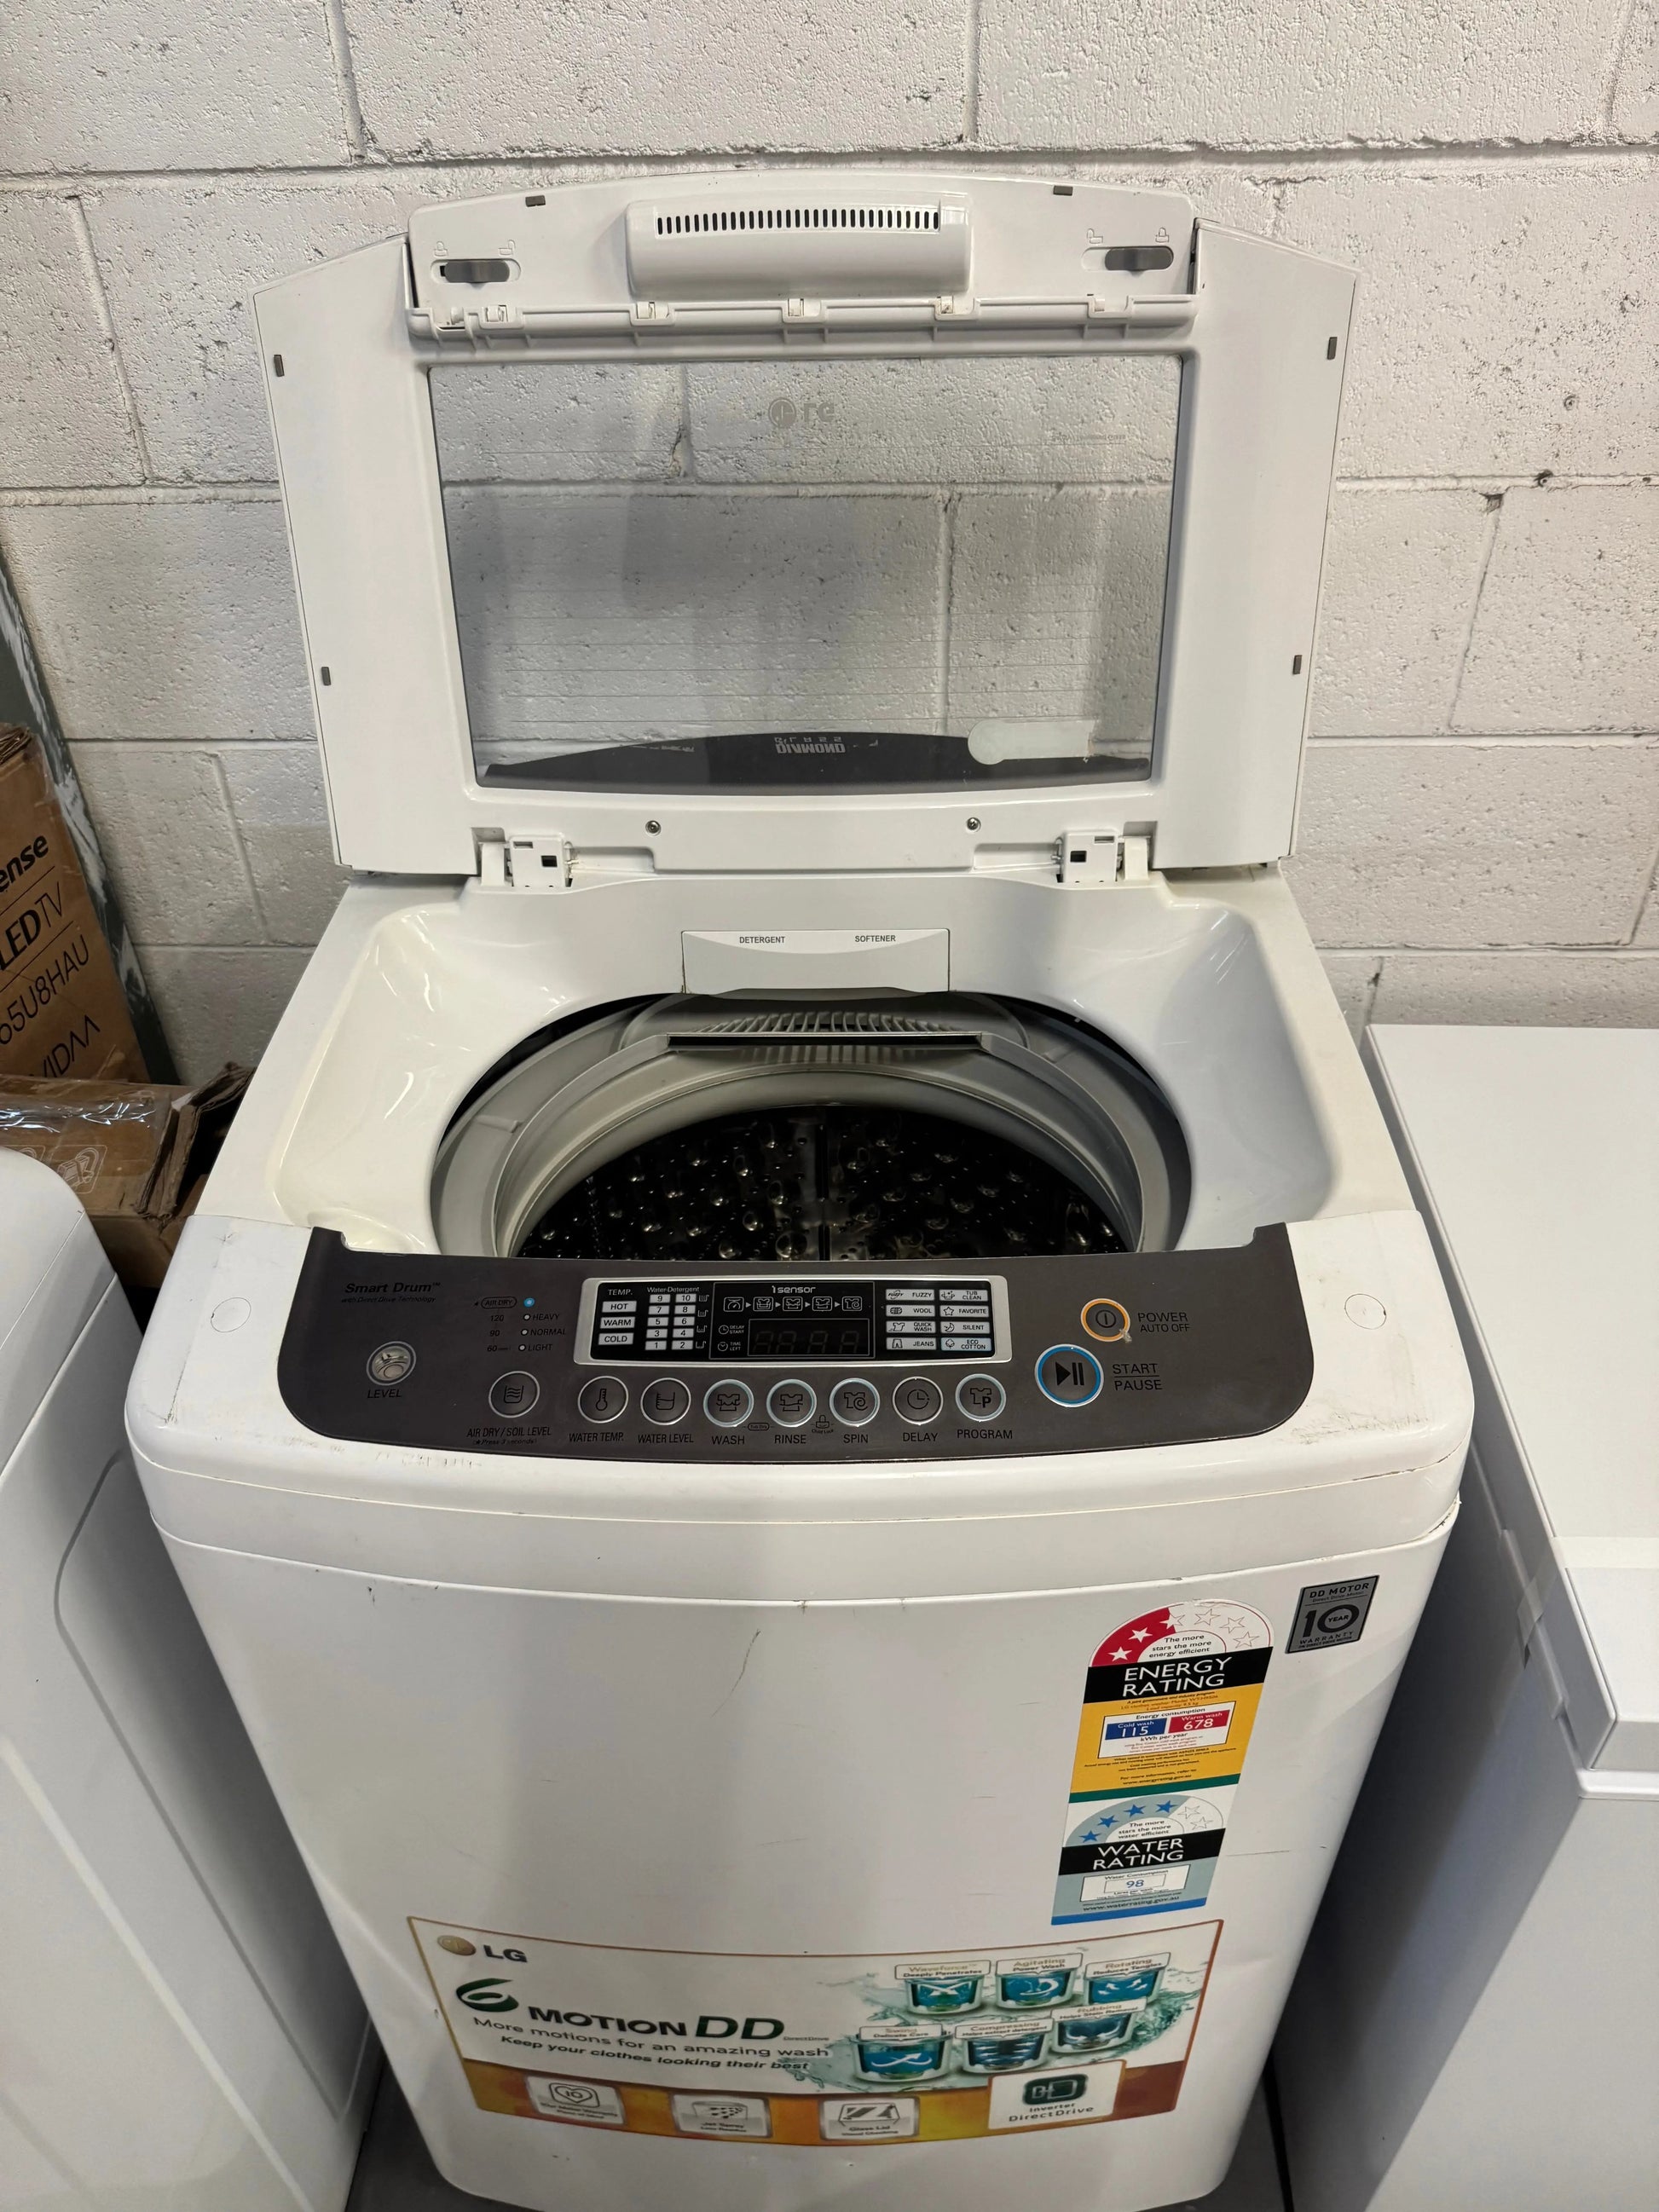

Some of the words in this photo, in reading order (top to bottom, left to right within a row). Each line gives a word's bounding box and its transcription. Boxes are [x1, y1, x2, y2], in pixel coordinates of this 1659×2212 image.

[344, 1283, 388, 1293] Smart
[610, 1302, 628, 1311] HOT
[1137, 1312, 1188, 1323] POWER
[1140, 1324, 1169, 1332] AUTO
[1171, 1323, 1190, 1332] OFF
[1112, 1363, 1158, 1375] START
[1114, 1379, 1163, 1391] PAUSE
[367, 1388, 402, 1399] LEVEL
[467, 1428, 481, 1438] AIR
[483, 1428, 500, 1438] DRY
[506, 1427, 525, 1437] SOIL
[527, 1426, 552, 1436] LEVEL
[569, 1432, 598, 1442] WATER
[600, 1432, 624, 1442] TEMP.
[903, 1432, 938, 1441] DELAY
[957, 1429, 1013, 1440] PROGRAM
[639, 1434, 667, 1444] WATER
[669, 1434, 694, 1443] LEVEL
[711, 1435, 745, 1445] WASH
[774, 1434, 806, 1444] RINSE
[843, 1434, 869, 1443] SPIN
[1309, 1590, 1325, 1598] DD
[1328, 1582, 1370, 1596] MOTOR
[1302, 1603, 1360, 1637] 10
[1327, 1614, 1350, 1623] YEAR
[1299, 1631, 1354, 1644] WARRANTY
[1124, 1656, 1233, 1682] ENERGY
[1122, 1673, 1226, 1697] RATING
[1161, 1707, 1205, 1717] consumption
[1183, 1718, 1214, 1730] 678
[1122, 1725, 1148, 1737] 115
[1097, 1838, 1183, 1857] WATER
[1092, 1851, 1184, 1871] RATING
[1126, 1880, 1144, 1888] 98
[483, 1944, 528, 1963] LG
[1014, 1958, 1066, 1967] Agitating
[1105, 1959, 1153, 1969] Rotating
[456, 1978, 519, 2012] 6
[528, 2006, 688, 2036] MOTION
[695, 2015, 785, 2041] DD
[1077, 2004, 1122, 2013] Rubbing
[970, 2021, 1040, 2032] Compressing
[473, 2017, 523, 2033] More
[530, 2028, 611, 2045] motions
[617, 2038, 645, 2048] for
[652, 2043, 676, 2052] an
[684, 2045, 771, 2058] amazing
[777, 2047, 830, 2057] wash
[501, 2036, 543, 2049] Keep
[547, 2043, 587, 2055] your
[590, 2048, 652, 2062] clothes
[657, 2053, 722, 2068] looking
[726, 2060, 766, 2069] their
[771, 2061, 809, 2070] best
[1029, 2102, 1076, 2113] Inverter
